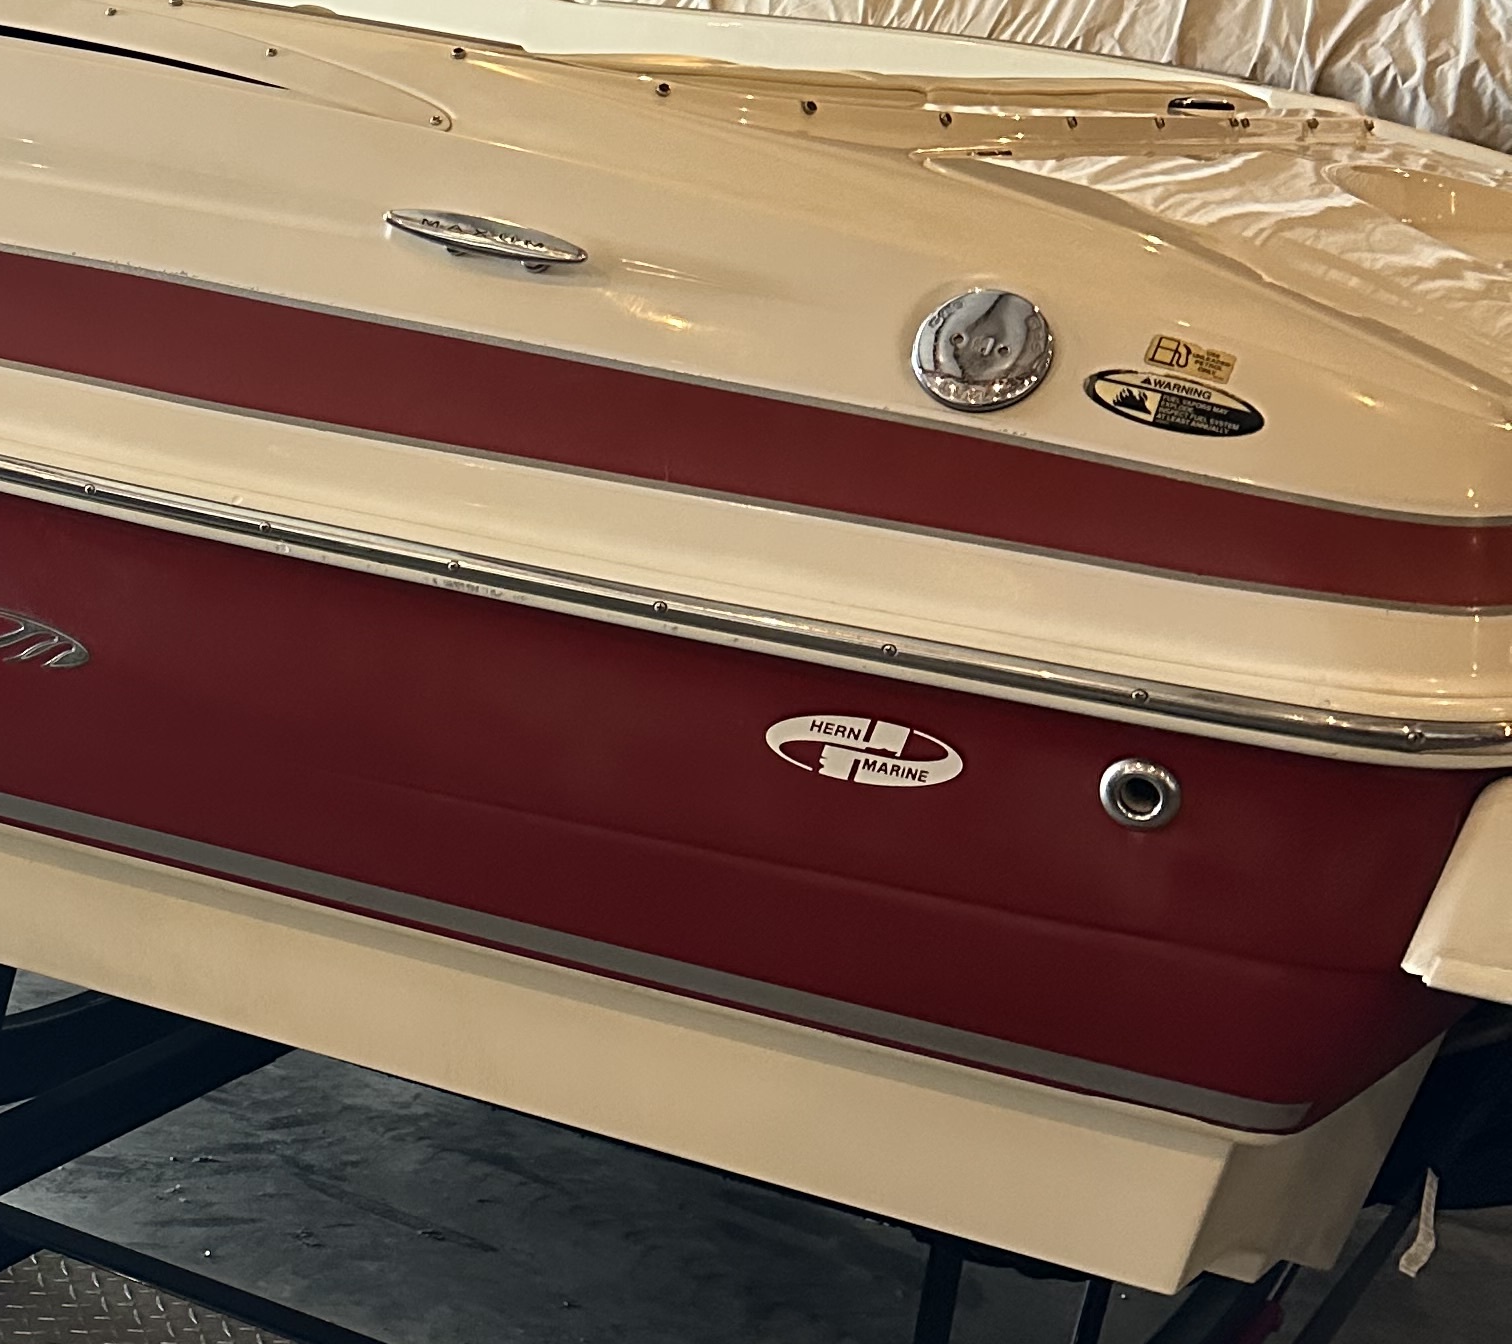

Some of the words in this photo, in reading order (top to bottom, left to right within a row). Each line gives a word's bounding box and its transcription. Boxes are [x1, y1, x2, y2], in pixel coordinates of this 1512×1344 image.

[421, 218, 545, 249] MAXUM
[1153, 378, 1212, 401] WARNING
[809, 719, 862, 741] HERN
[861, 758, 930, 783] MARINE
